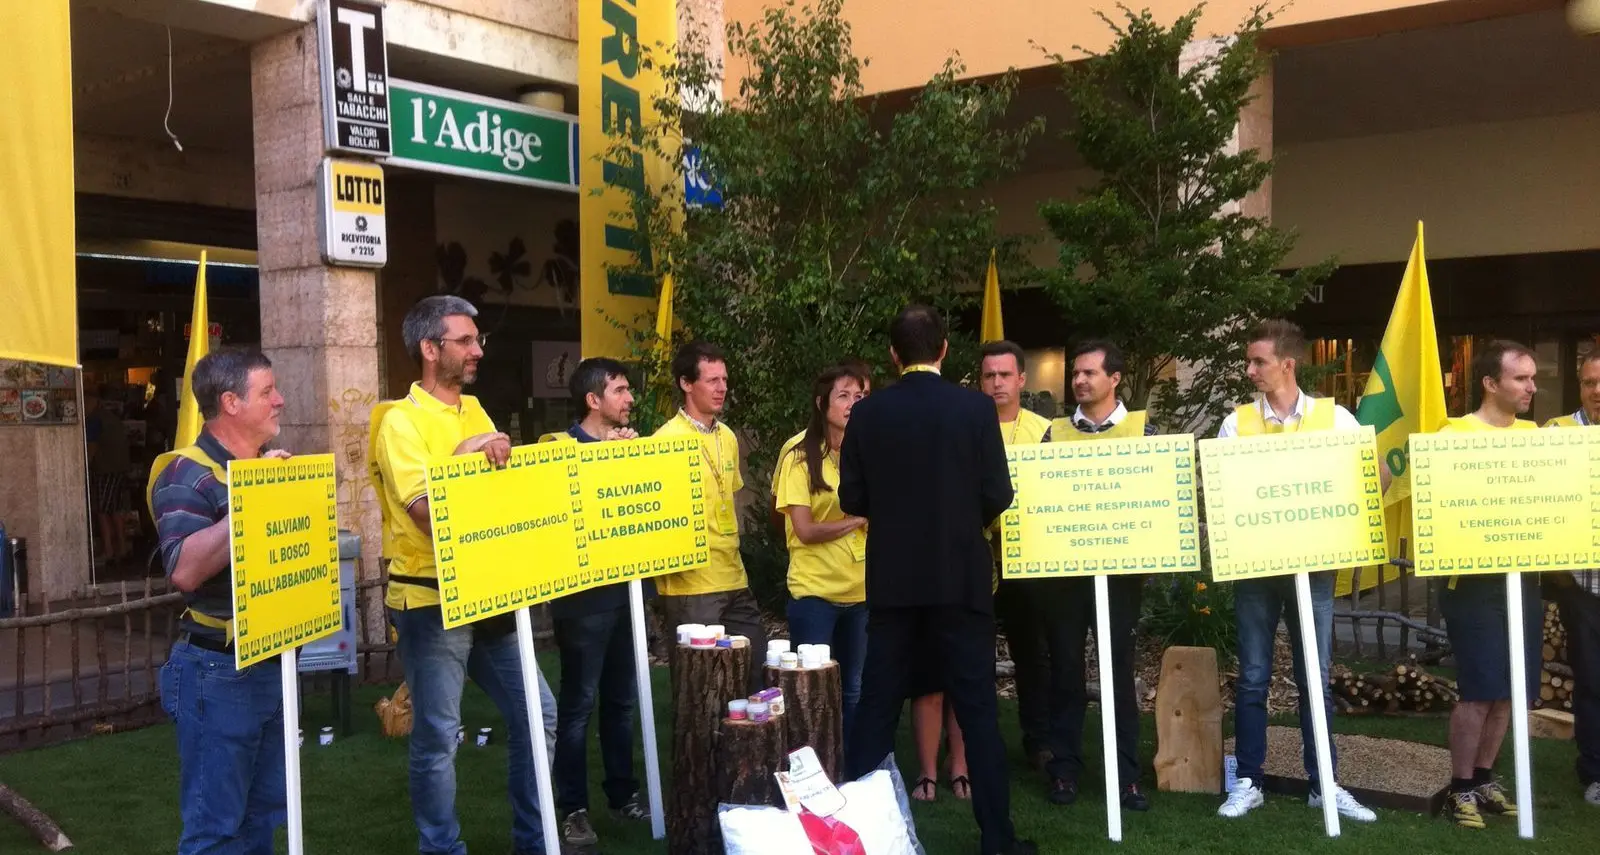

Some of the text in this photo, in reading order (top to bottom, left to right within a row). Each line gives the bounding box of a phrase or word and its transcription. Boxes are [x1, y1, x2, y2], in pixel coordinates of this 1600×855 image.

[337, 7, 375, 92] T
[347, 92, 366, 104] SALI
[338, 101, 386, 121] TABACCHI
[350, 125, 377, 138] VALORI
[411, 98, 542, 171] l'Adige
[349, 135, 379, 149] BOLLATI
[602, 0, 657, 298] RETTI
[336, 174, 381, 205] LOTTO
[341, 233, 381, 244] RICEVITORIA
[359, 246, 375, 256] 2215
[1453, 458, 1567, 471] FORESTE E BOSCHI
[1040, 469, 1093, 479] FORESTE
[1109, 466, 1153, 475] BOSCHI
[1487, 474, 1535, 484] D'ITALIA
[597, 480, 662, 499] SALVIAMO
[1073, 482, 1121, 491] D'ITALIA
[1256, 480, 1334, 499] GESTIRE
[1027, 499, 1170, 514] L'ARIA CHE RESPIRIAMO
[1440, 494, 1583, 508] L'ARIA CHE RESPIRIAMO
[602, 501, 661, 518] IL BOSCO
[1235, 503, 1359, 527] CUSTODENDO
[266, 515, 310, 537] SALVIAMO
[459, 512, 568, 544] #ORGOGLIOBOSCAIOLO
[1047, 520, 1152, 533] L'ENERGIA CHE CI
[1460, 516, 1565, 528] L'ENERGIA CHE CI
[1070, 536, 1129, 547] SOSTIENE
[1484, 532, 1543, 542] SOSTIENE
[269, 542, 309, 564] IL BOSCO
[251, 563, 328, 598] DALL'ABBANDONO
